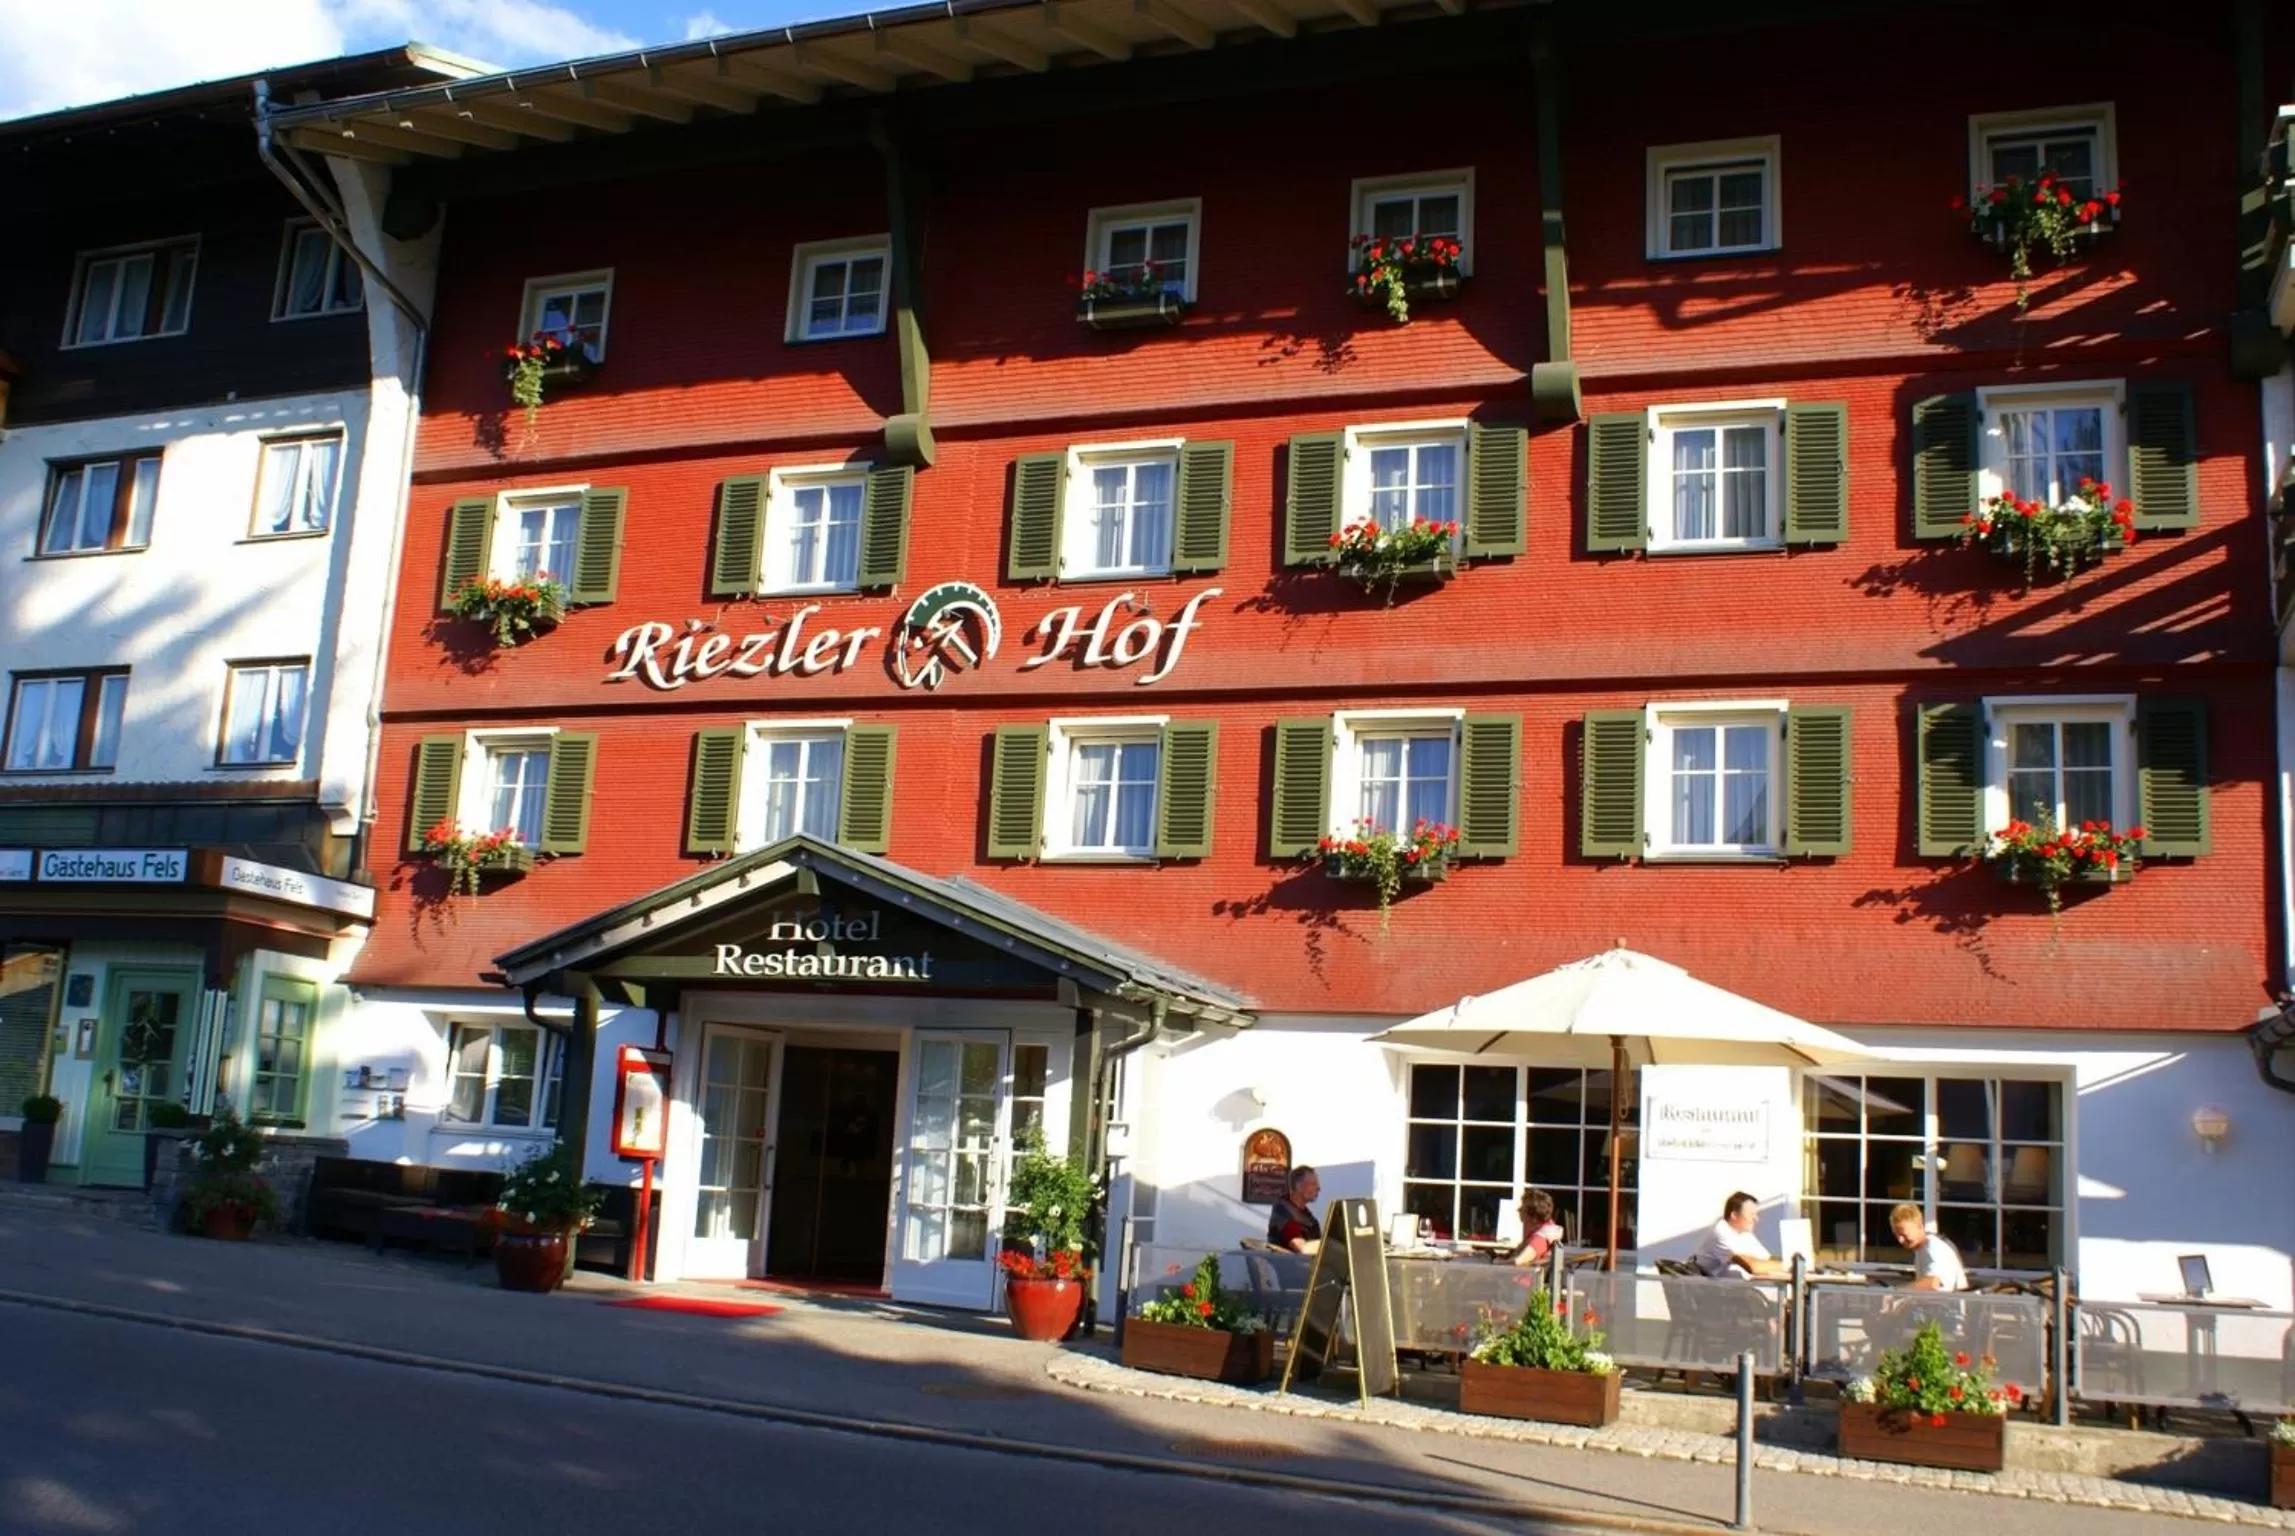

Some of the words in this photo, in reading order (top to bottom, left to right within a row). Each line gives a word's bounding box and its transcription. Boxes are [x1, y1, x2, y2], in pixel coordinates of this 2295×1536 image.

[604, 605, 881, 690] Riezler
[1028, 588, 1223, 685] Hof
[44, 853, 136, 877] Gästehaus
[141, 853, 180, 878] Fels
[767, 909, 881, 941] Hotel
[712, 943, 935, 979] Restaurant
[1660, 1104, 1761, 1124] Restaurant
